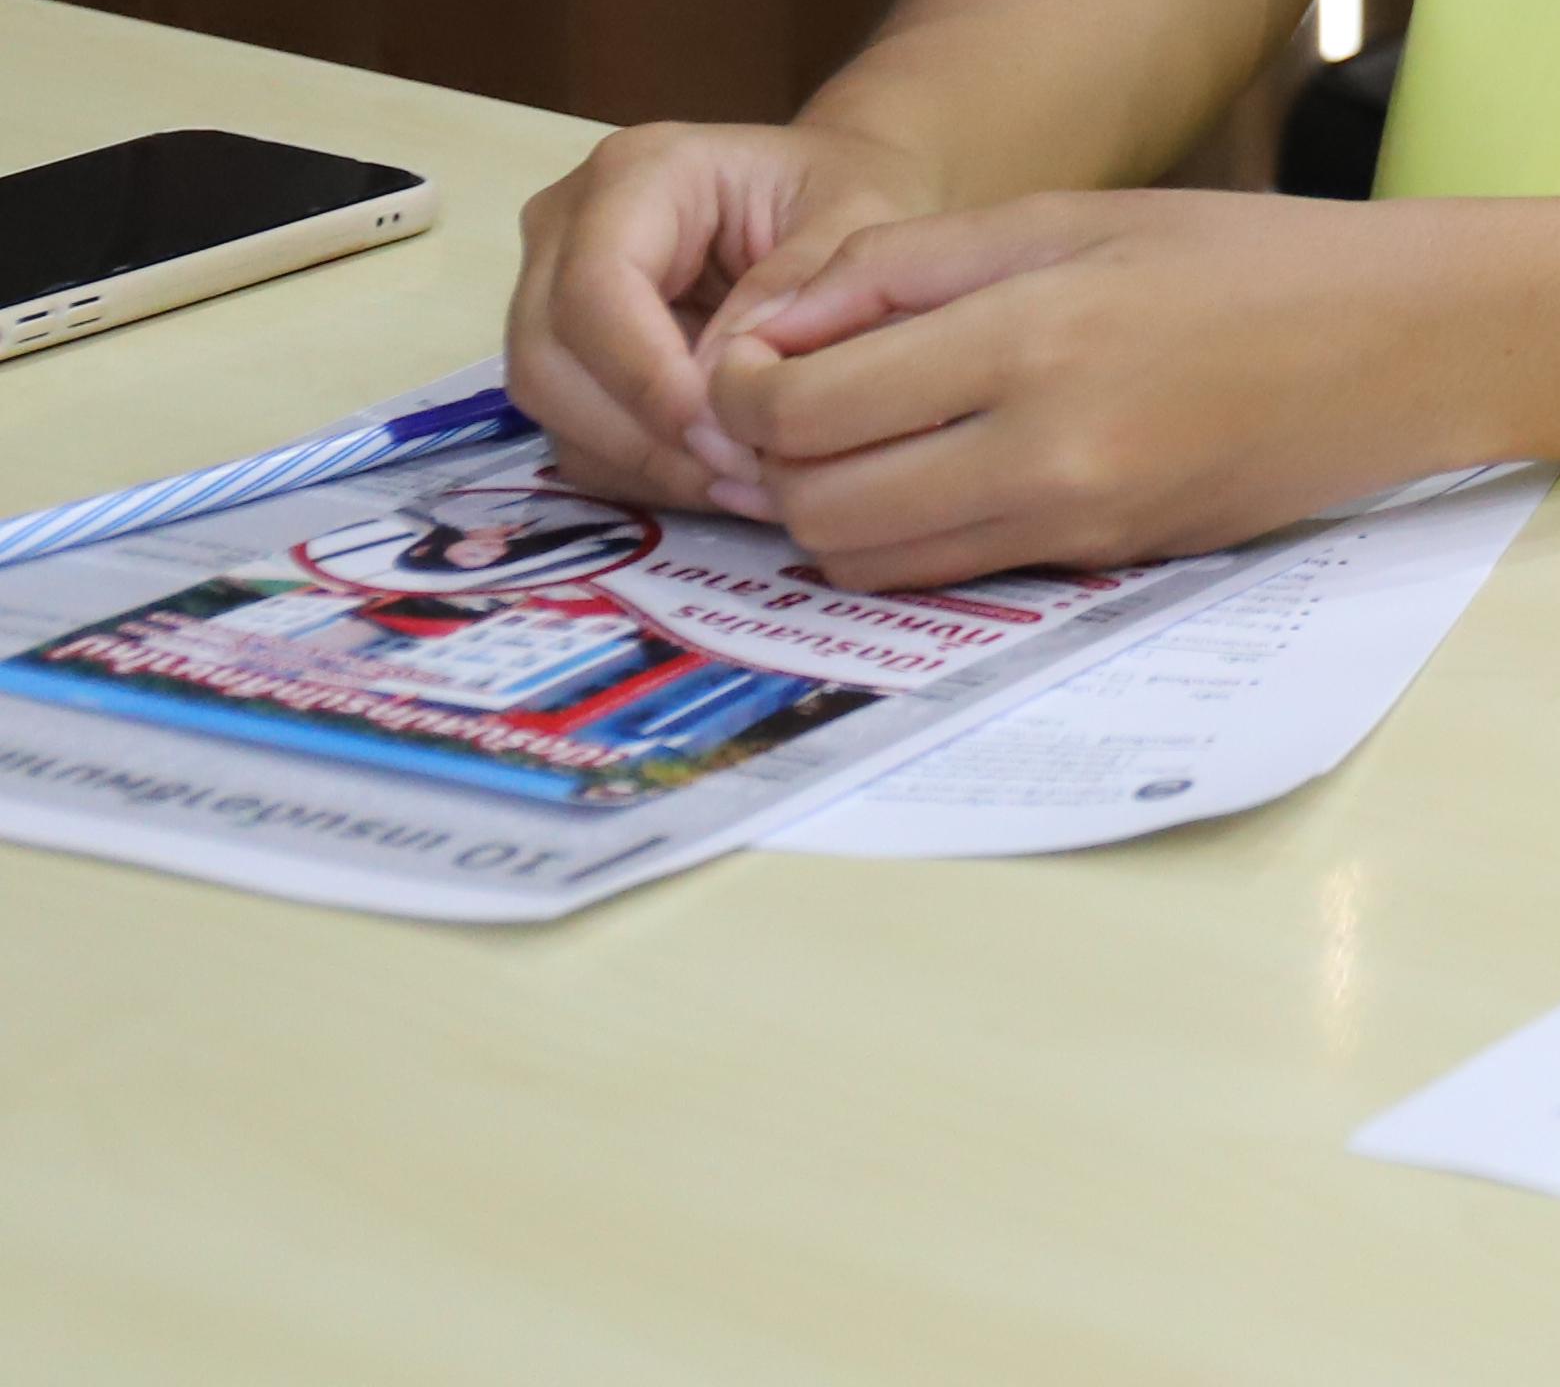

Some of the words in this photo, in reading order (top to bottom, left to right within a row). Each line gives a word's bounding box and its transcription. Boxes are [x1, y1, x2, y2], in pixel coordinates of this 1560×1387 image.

[668, 603, 946, 674] เปิดรับสมัคร
[819, 601, 1005, 652] ทั้งหมด
